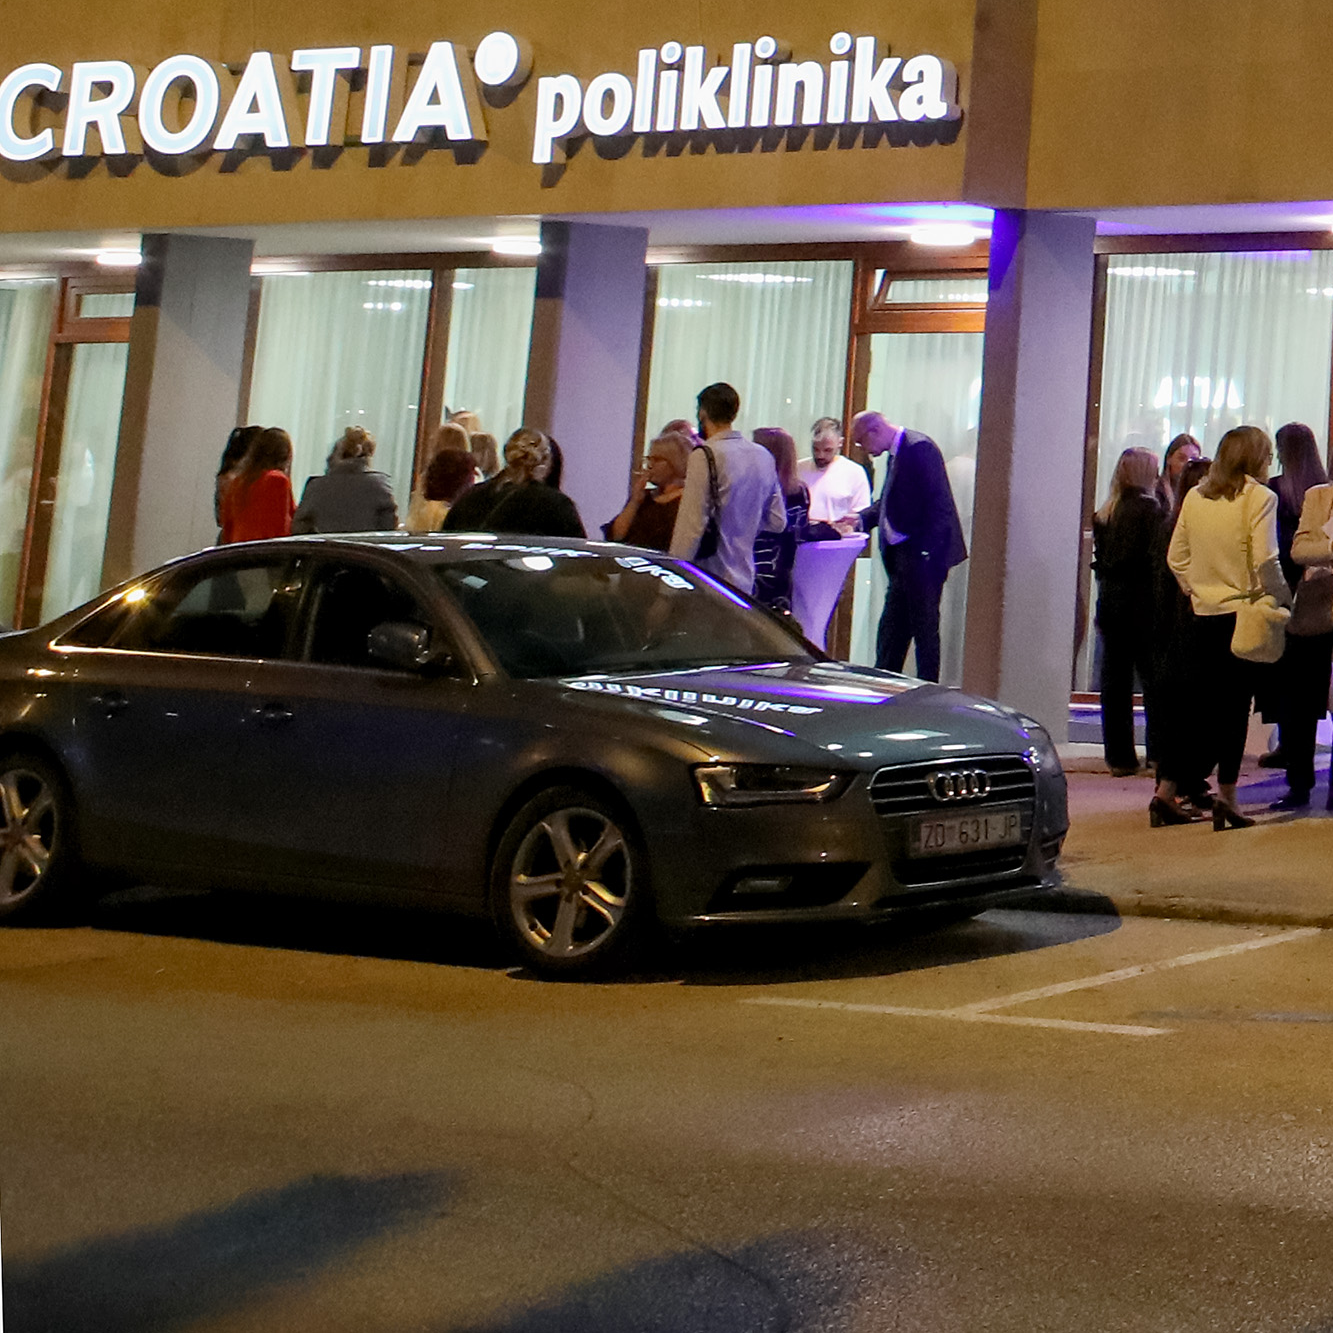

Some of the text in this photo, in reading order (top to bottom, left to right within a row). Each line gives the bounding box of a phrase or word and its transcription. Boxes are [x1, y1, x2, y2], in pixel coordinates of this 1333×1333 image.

[0, 32, 948, 164] CROATIA poliklinika
[924, 823, 946, 848] ZD
